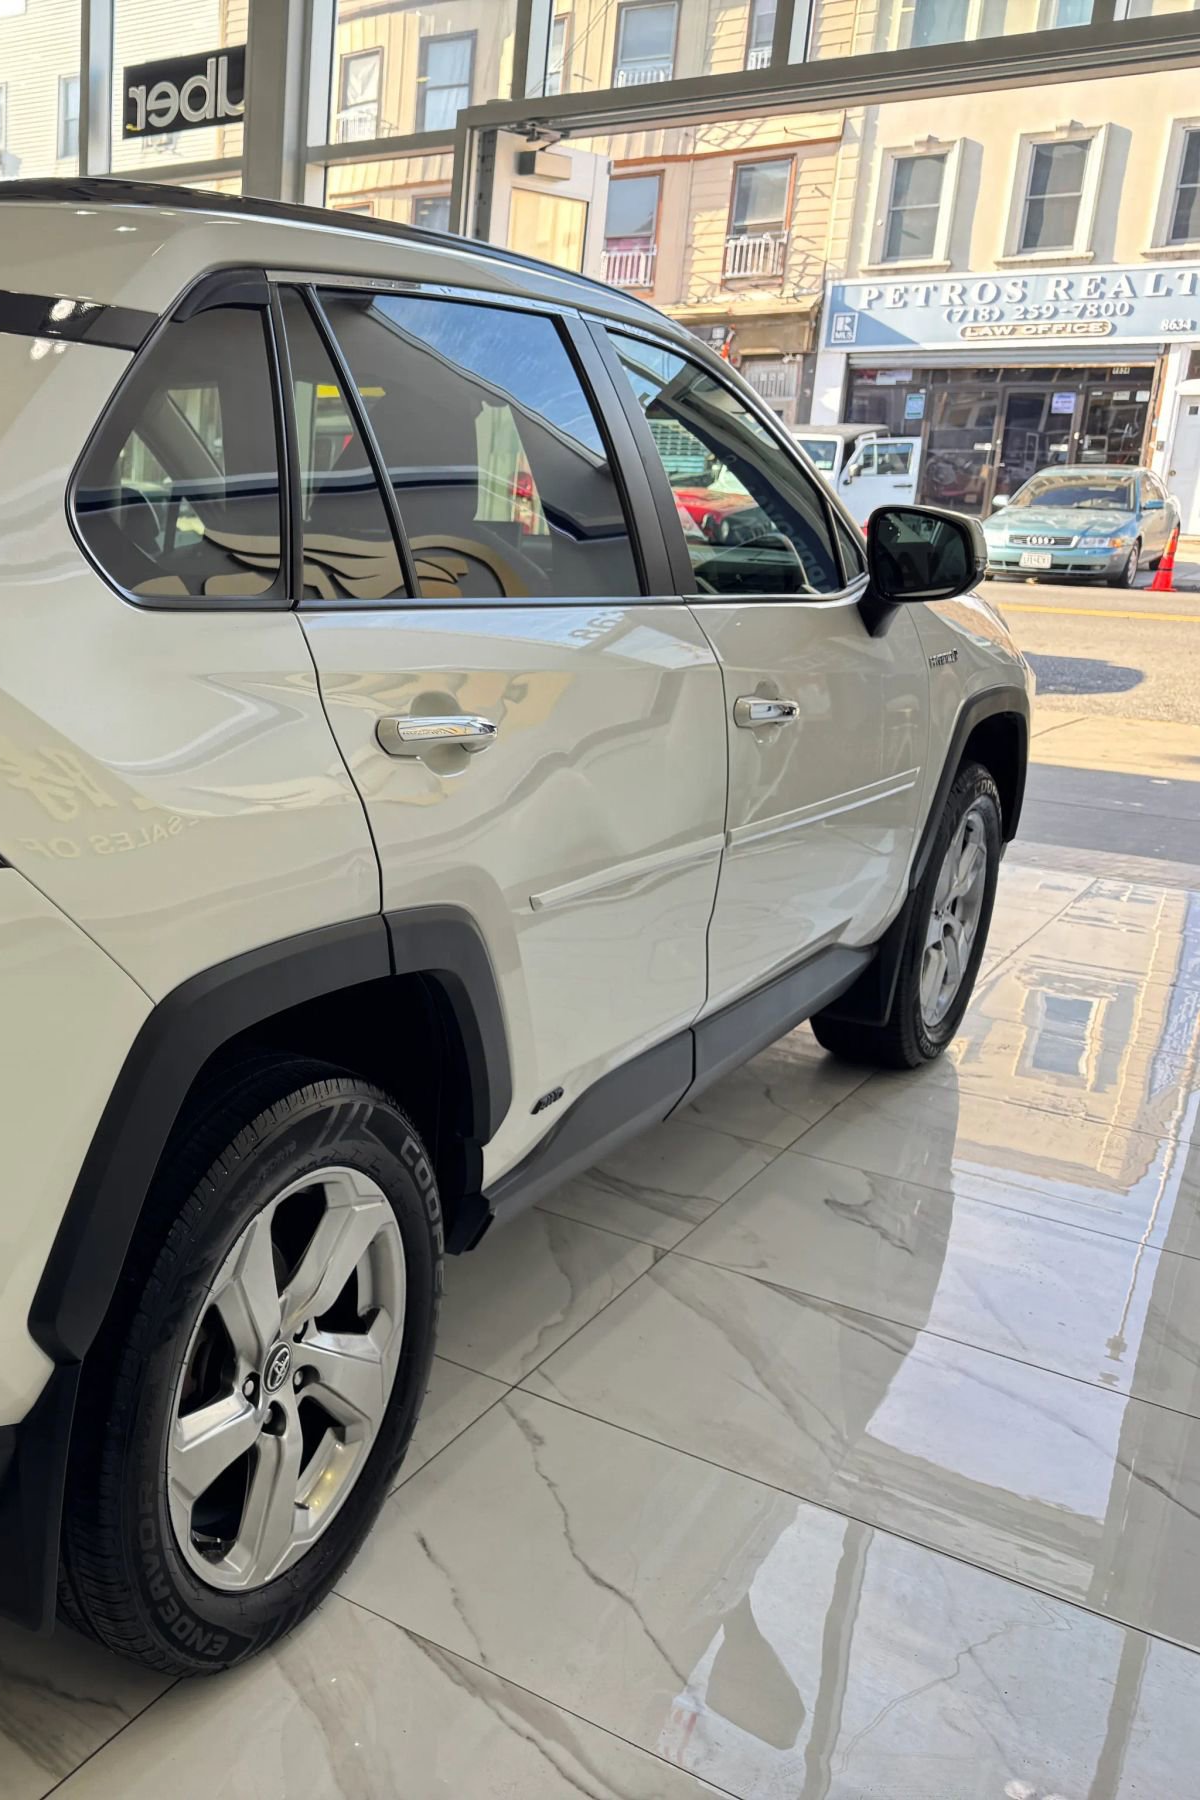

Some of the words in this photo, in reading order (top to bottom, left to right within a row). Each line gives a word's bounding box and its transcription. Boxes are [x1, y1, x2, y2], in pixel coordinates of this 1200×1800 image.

[858, 279, 1028, 310] PETROS
[943, 306, 1003, 323] (718)
[1012, 300, 1132, 320] 259-7800
[964, 326, 1014, 338] LAW
[1022, 321, 1104, 336] OFFICE
[1160, 318, 1193, 332] 8634
